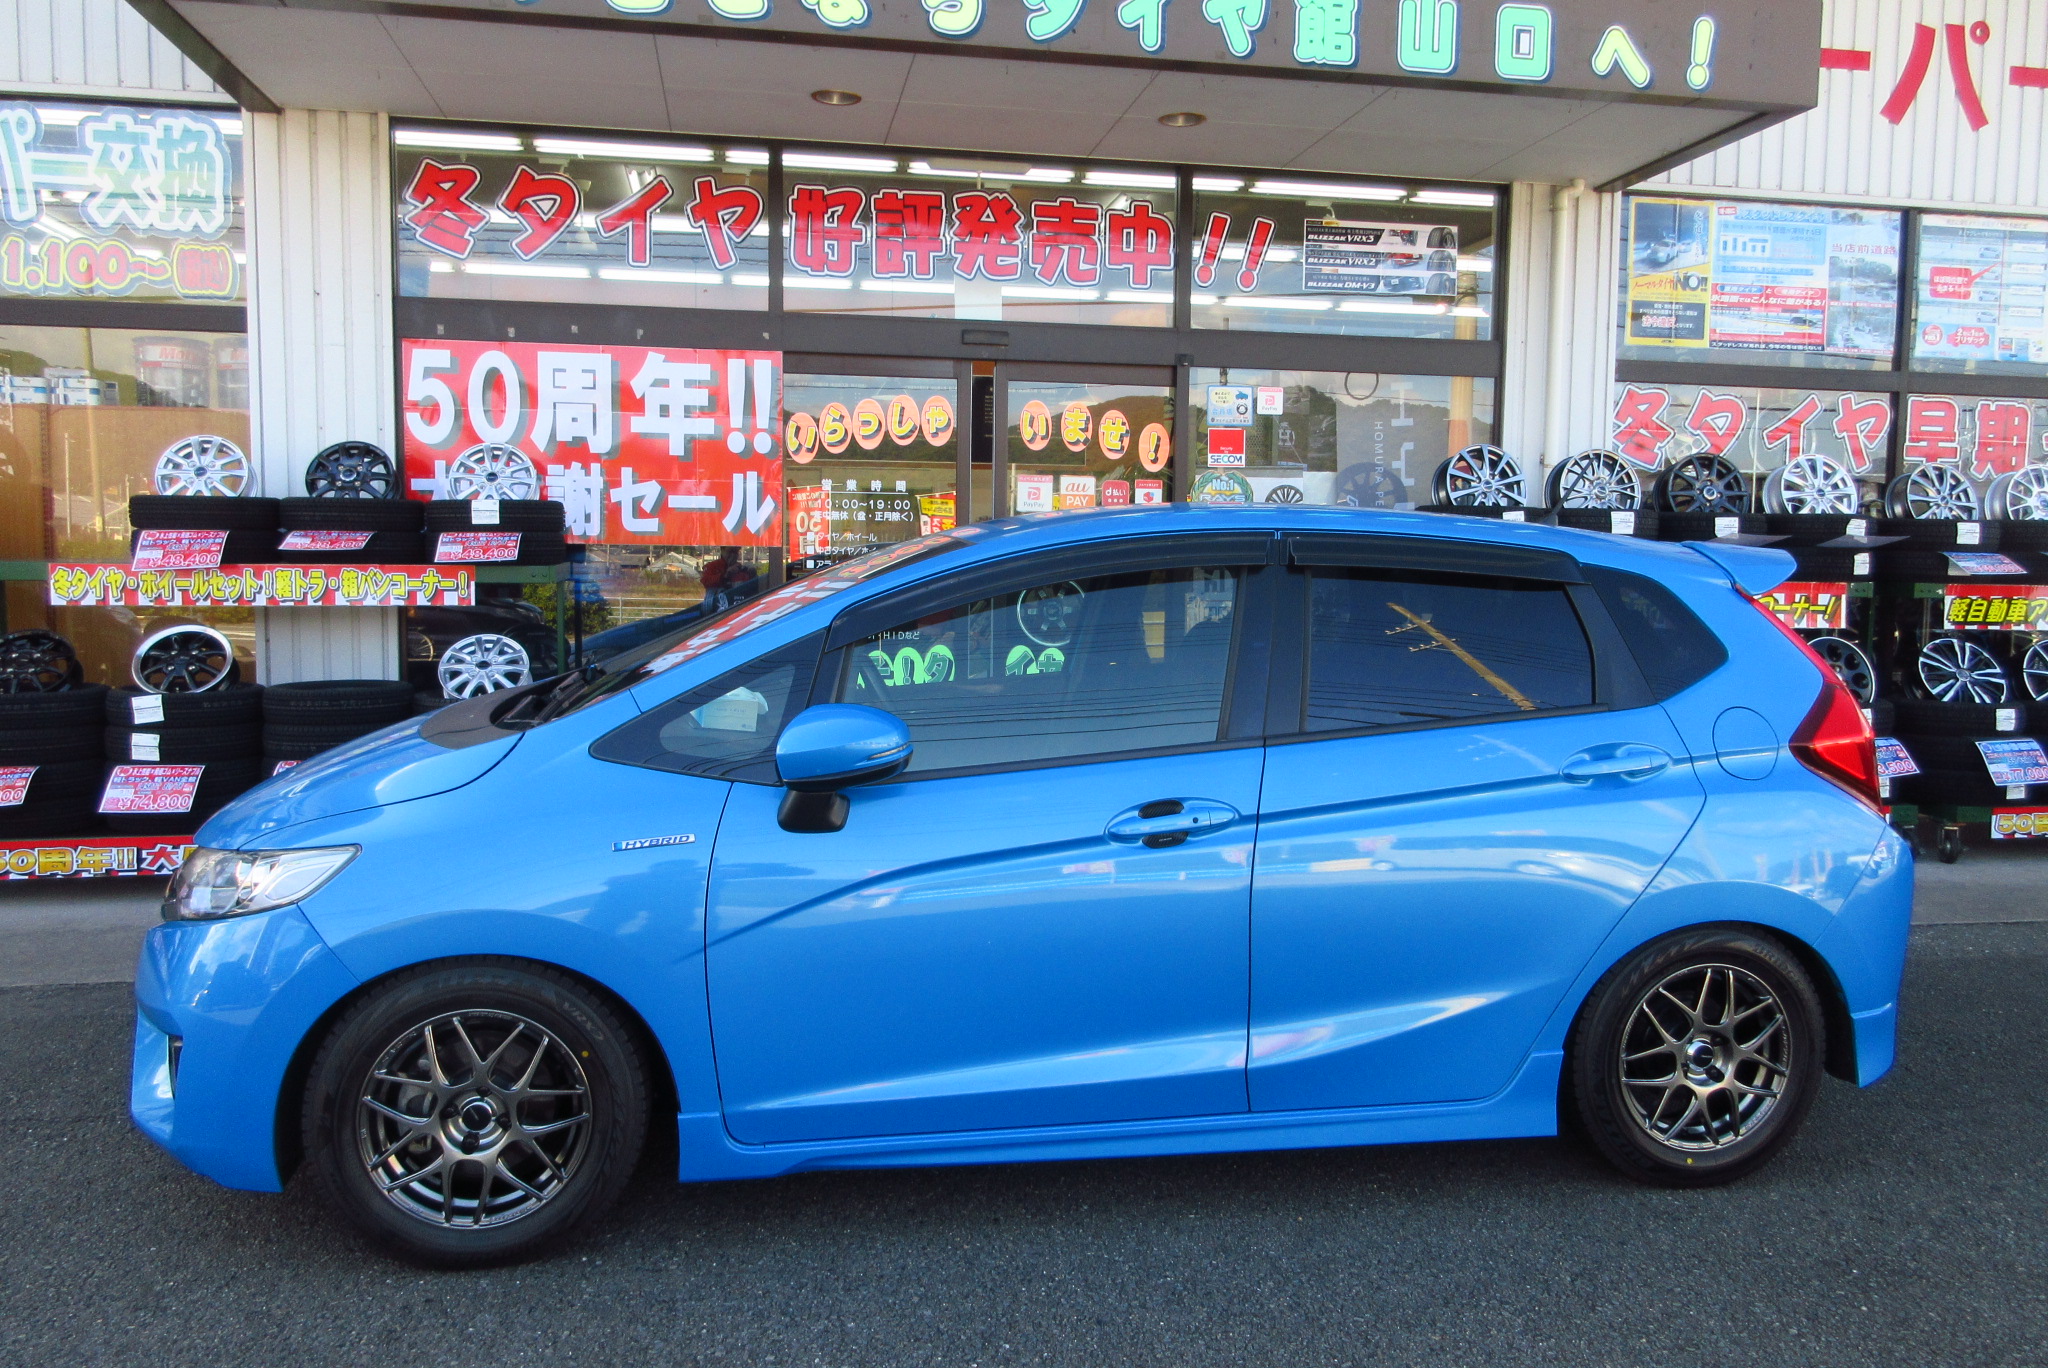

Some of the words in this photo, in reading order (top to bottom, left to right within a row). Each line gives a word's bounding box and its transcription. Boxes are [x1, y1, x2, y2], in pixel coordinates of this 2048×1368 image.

[1307, 234, 1347, 242] BLIZZAK
[1347, 234, 1375, 243] VRX3
[1831, 243, 1897, 255] 当店前道路
[1307, 257, 1348, 265] BLIZZAK
[1348, 257, 1377, 266] VRX2
[1343, 281, 1375, 290] DM-V3
[406, 349, 773, 456] 50周年!!
[1374, 421, 1384, 484] HOMURA
[1210, 455, 1243, 464] SECOM
[821, 478, 907, 493] 営業時間
[1065, 482, 1091, 493] au
[1212, 478, 1235, 491] No.1
[1105, 487, 1126, 496] d払い
[410, 459, 776, 539] 大謝セール
[1066, 496, 1089, 506] PAY
[1200, 493, 1246, 503] RAYS
[1023, 501, 1045, 509] PayPay
[1947, 597, 2048, 623] 軽自動車ア
[624, 834, 691, 850] HYBRID
